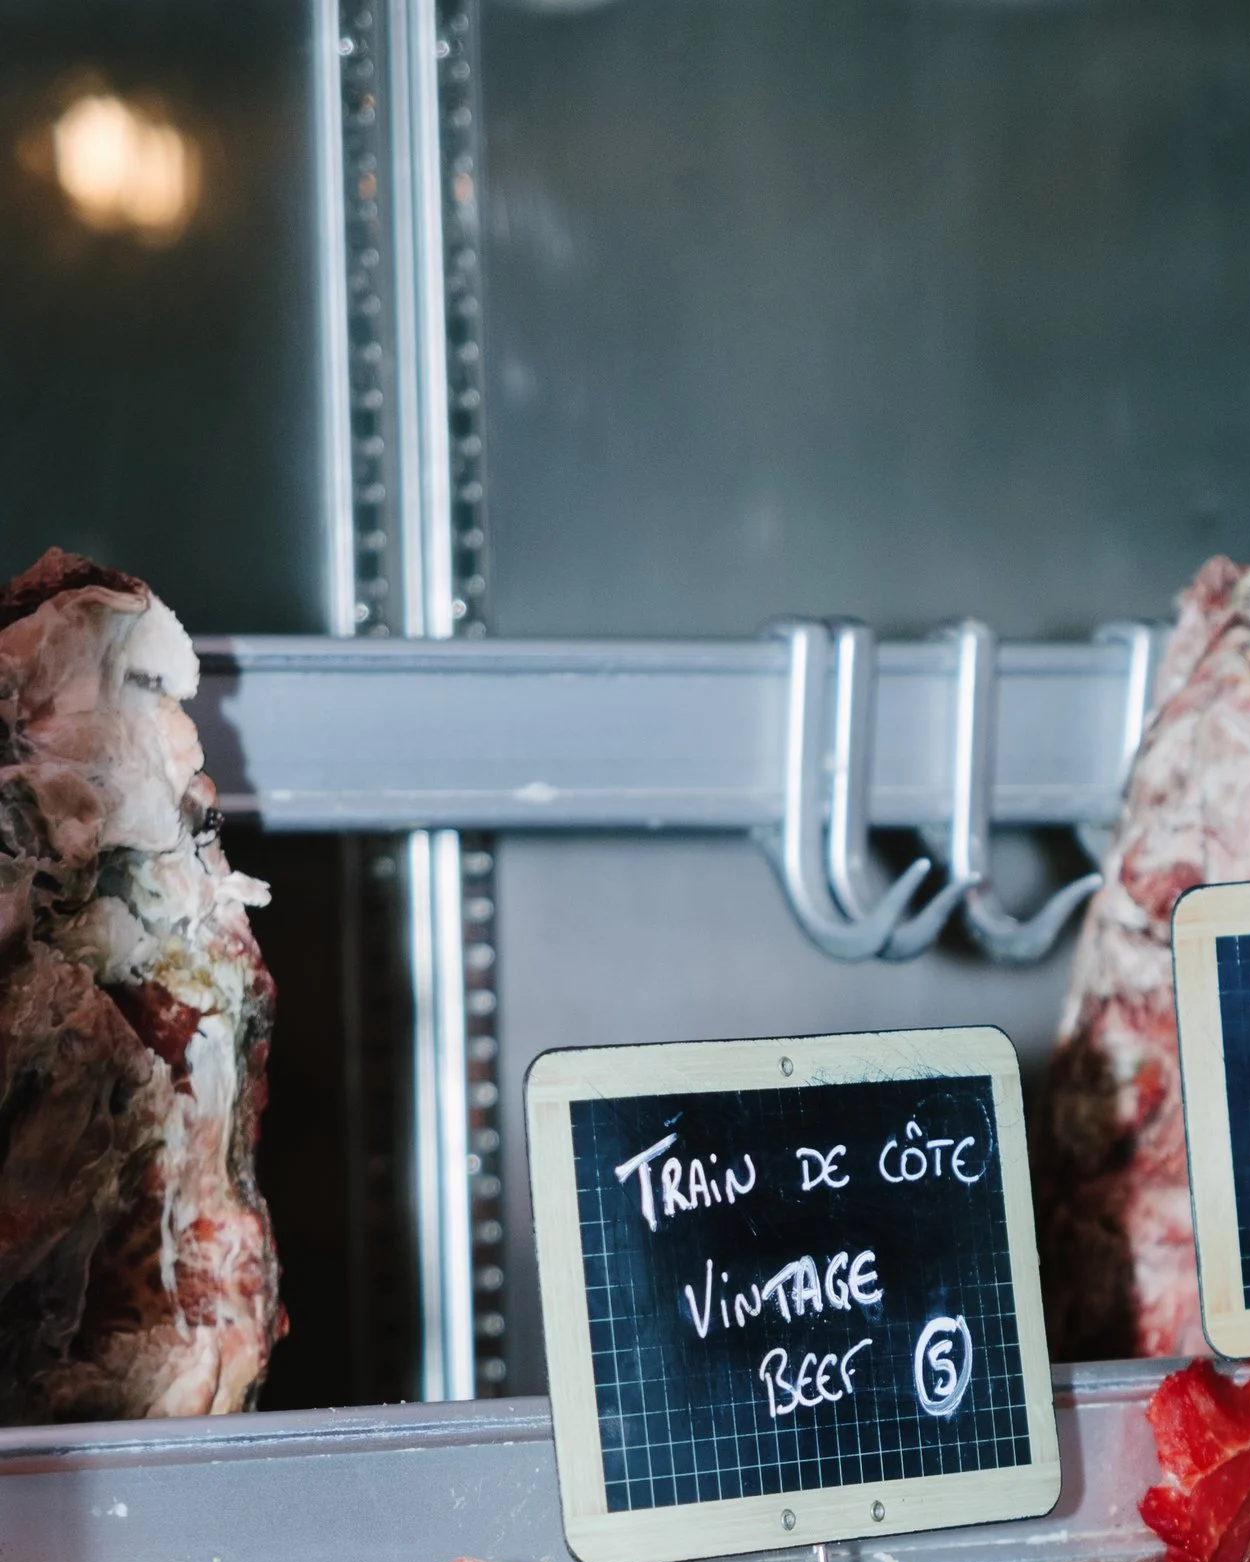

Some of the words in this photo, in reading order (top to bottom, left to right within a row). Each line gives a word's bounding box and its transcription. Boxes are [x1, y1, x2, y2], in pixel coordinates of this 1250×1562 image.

[796, 1144, 850, 1190] DE
[879, 1121, 980, 1186] CÔTE
[759, 1338, 873, 1418] BEEF
